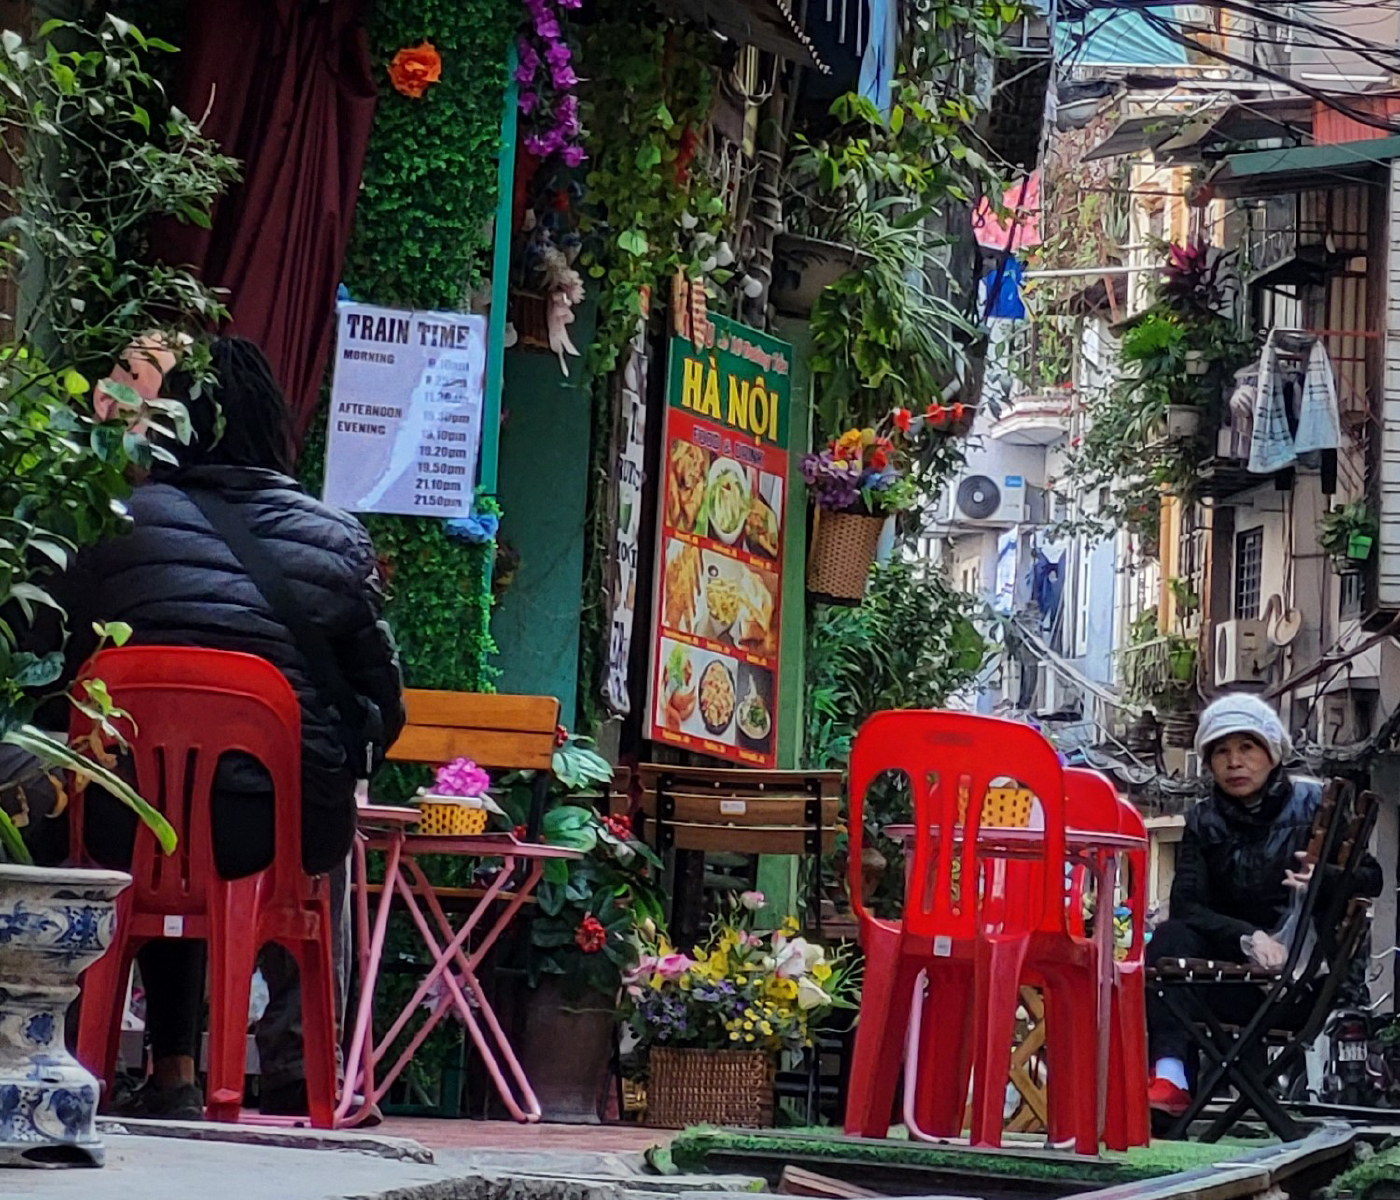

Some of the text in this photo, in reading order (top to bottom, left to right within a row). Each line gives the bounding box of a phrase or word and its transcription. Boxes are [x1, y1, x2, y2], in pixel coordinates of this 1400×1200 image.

[347, 313, 470, 350] TRAIN TIME
[343, 349, 396, 364] MORNING
[681, 357, 779, 446] HÀ NỘI
[338, 402, 402, 418] AFTERNOON
[337, 420, 386, 435] EVENING
[693, 425, 721, 452] FOOD
[419, 445, 467, 459] 19.20pm
[417, 461, 466, 476] 19.50pm
[415, 478, 462, 491] 21.10pm
[413, 494, 462, 508] 21.50pm
